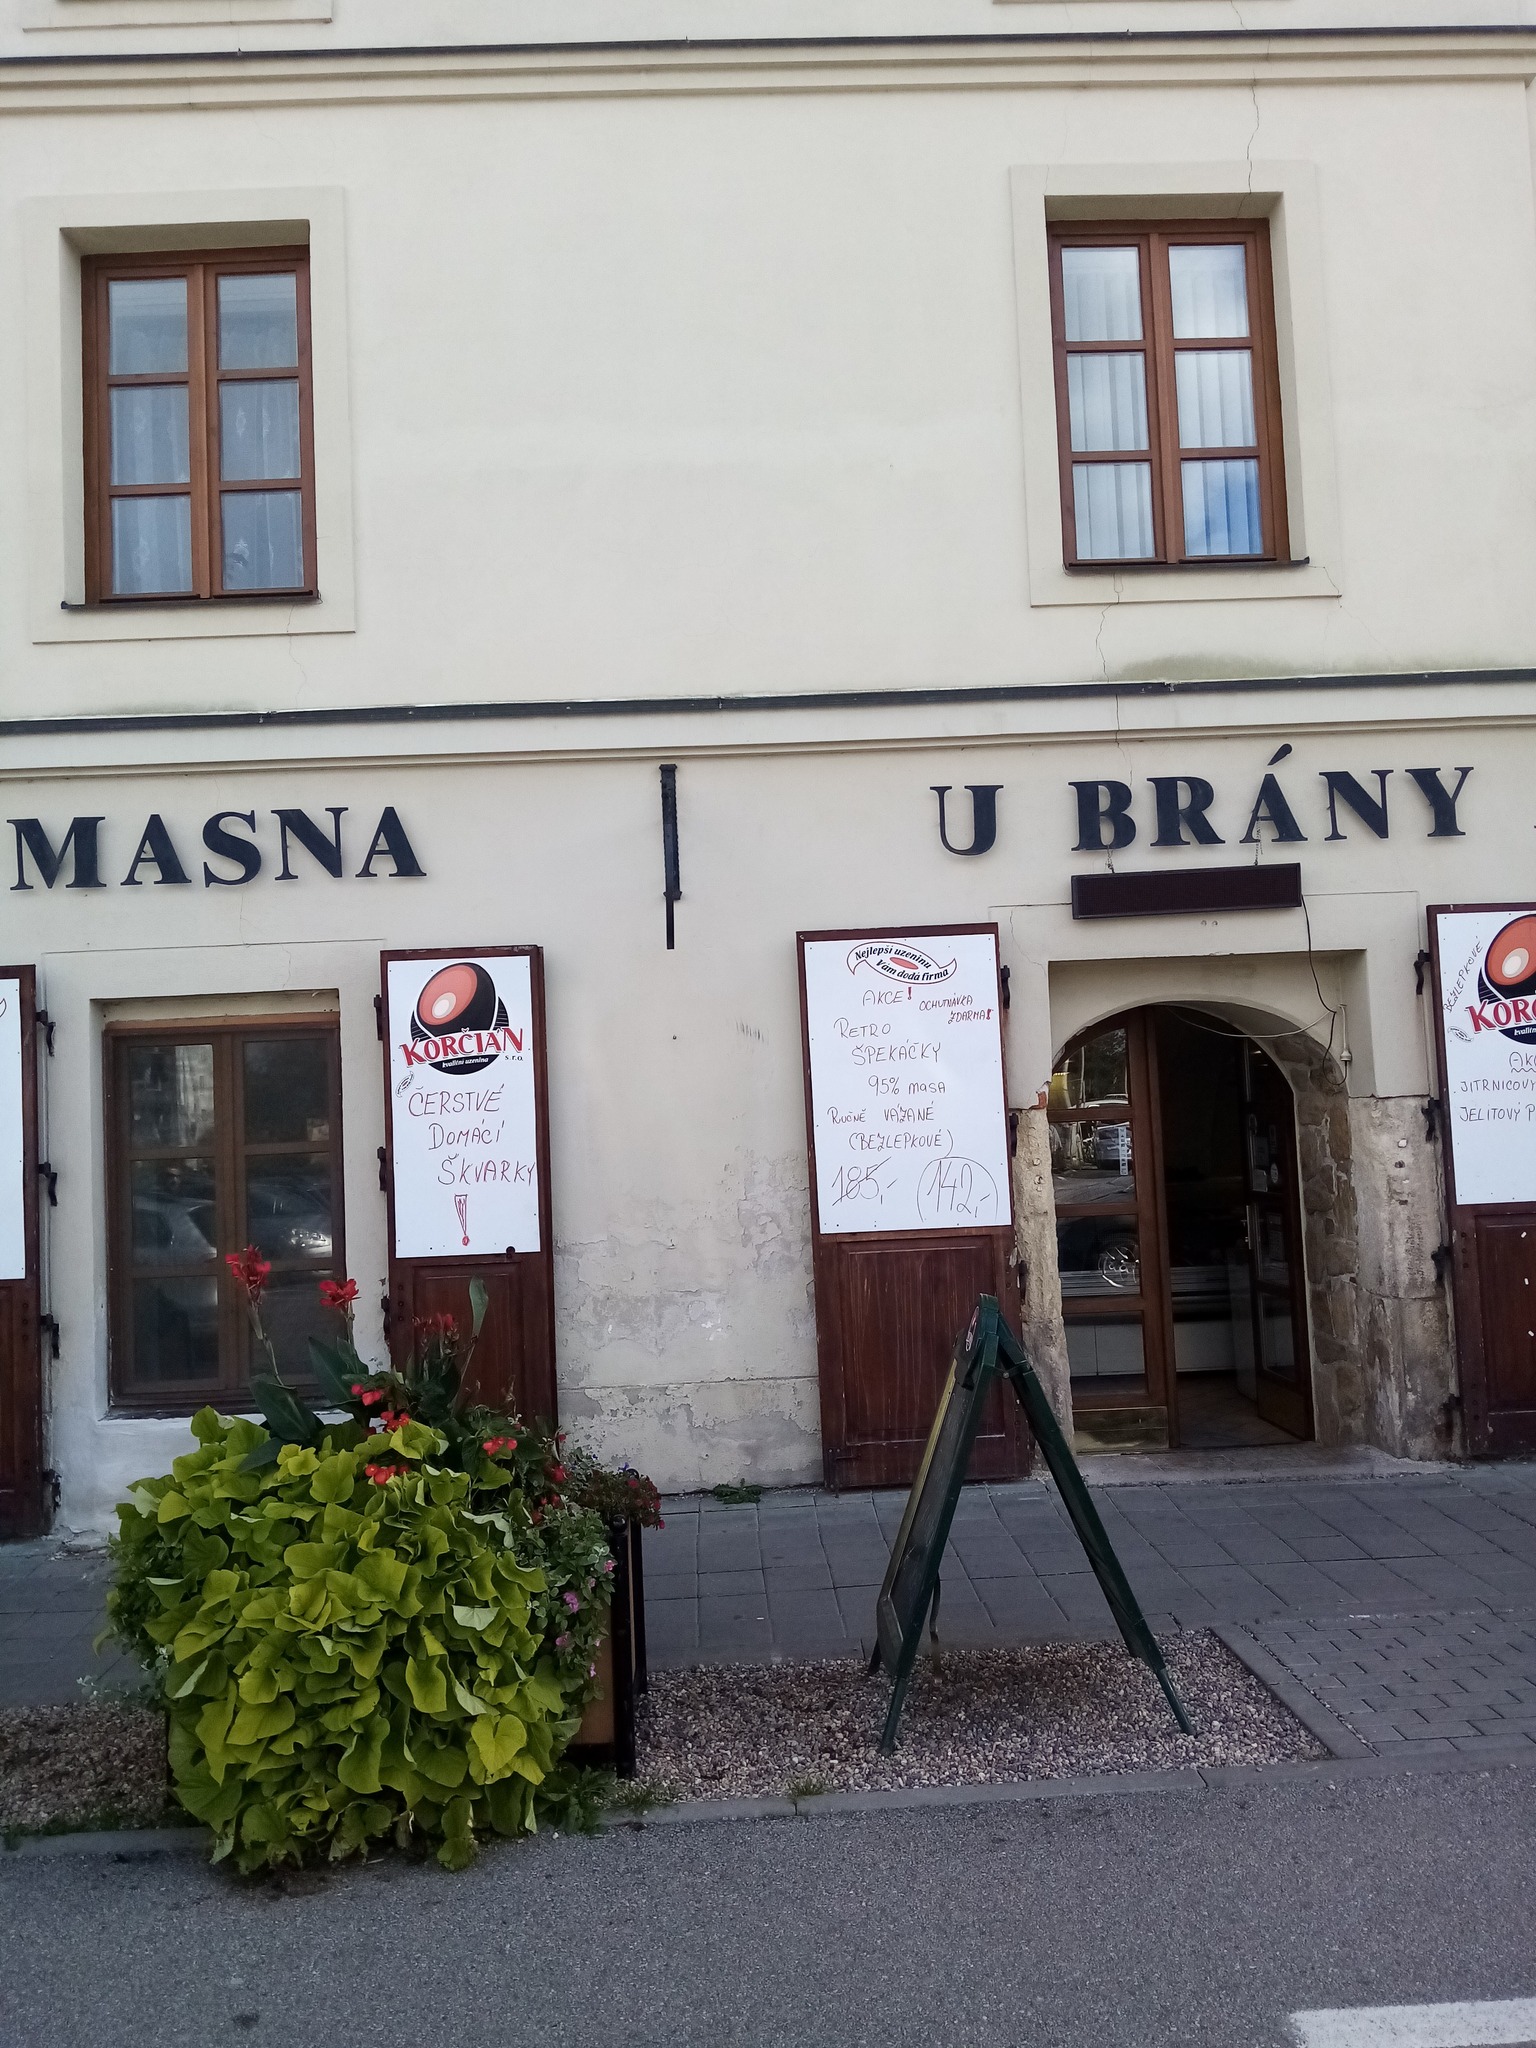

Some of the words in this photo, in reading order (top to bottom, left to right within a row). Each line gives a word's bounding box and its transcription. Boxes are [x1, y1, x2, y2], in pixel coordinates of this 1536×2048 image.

[6, 806, 427, 891] MASNA
[930, 784, 1005, 857] U
[1068, 742, 1475, 852] BRÁNY
[854, 943, 894, 961] Nejlepší
[893, 948, 933, 969] uzeninu
[875, 958, 897, 976] Vám
[896, 971, 921, 981] dodá
[921, 968, 949, 982] firma
[833, 1016, 892, 1039] RETRO
[1464, 998, 1536, 1034] KOR
[399, 1026, 524, 1068] KORČIÁN
[851, 1038, 942, 1066] ŠPEKÁČKY
[1508, 1051, 1536, 1068] AK
[868, 1074, 900, 1097] 95%
[408, 1083, 505, 1117] ČERSTVÉ
[437, 1153, 536, 1187] ŠKVARKY
